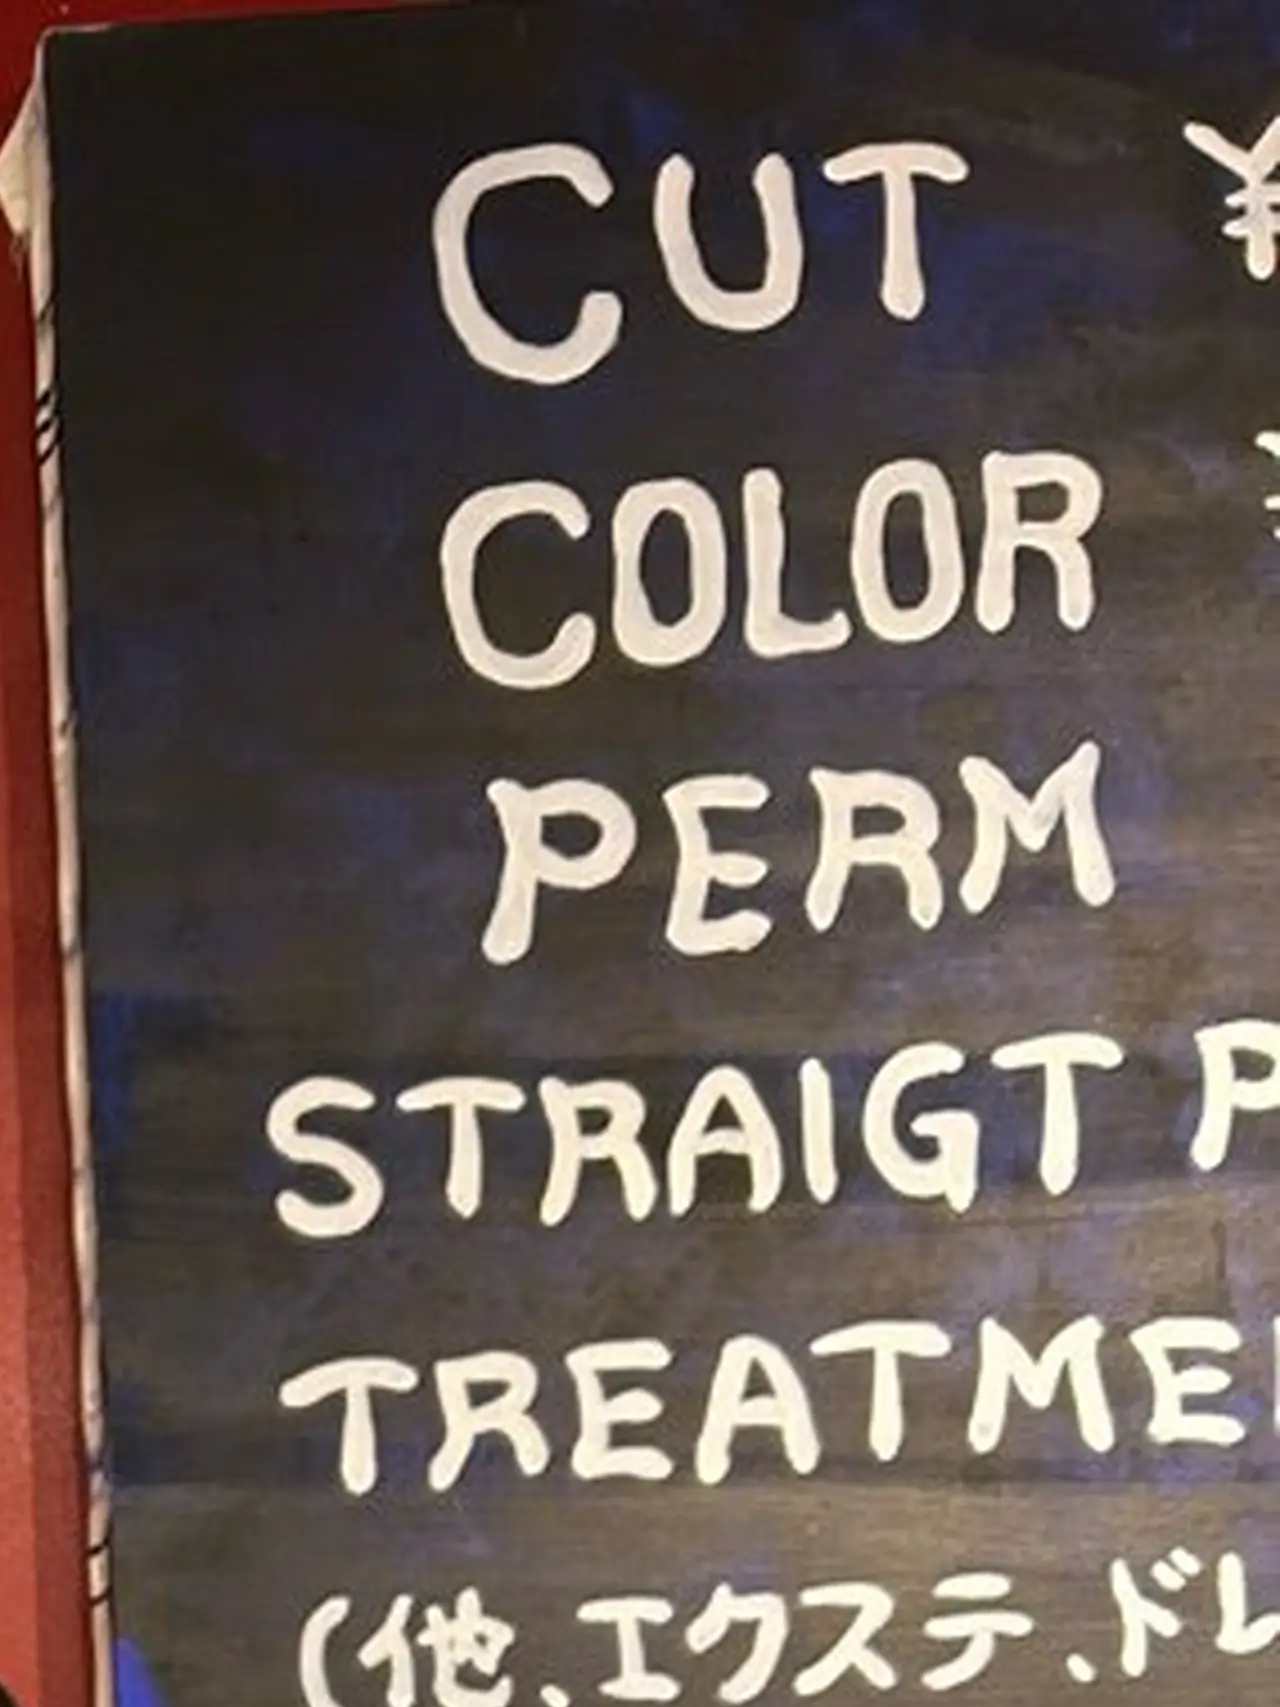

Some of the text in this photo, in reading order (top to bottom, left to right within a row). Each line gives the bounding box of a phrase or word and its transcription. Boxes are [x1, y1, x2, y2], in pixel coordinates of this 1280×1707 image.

[433, 142, 969, 386] CUT
[439, 450, 1104, 690] COLOR
[481, 740, 1117, 966] PERM
[265, 1030, 1126, 1240] STRAIGT
[278, 1313, 1280, 1496] TREATME
